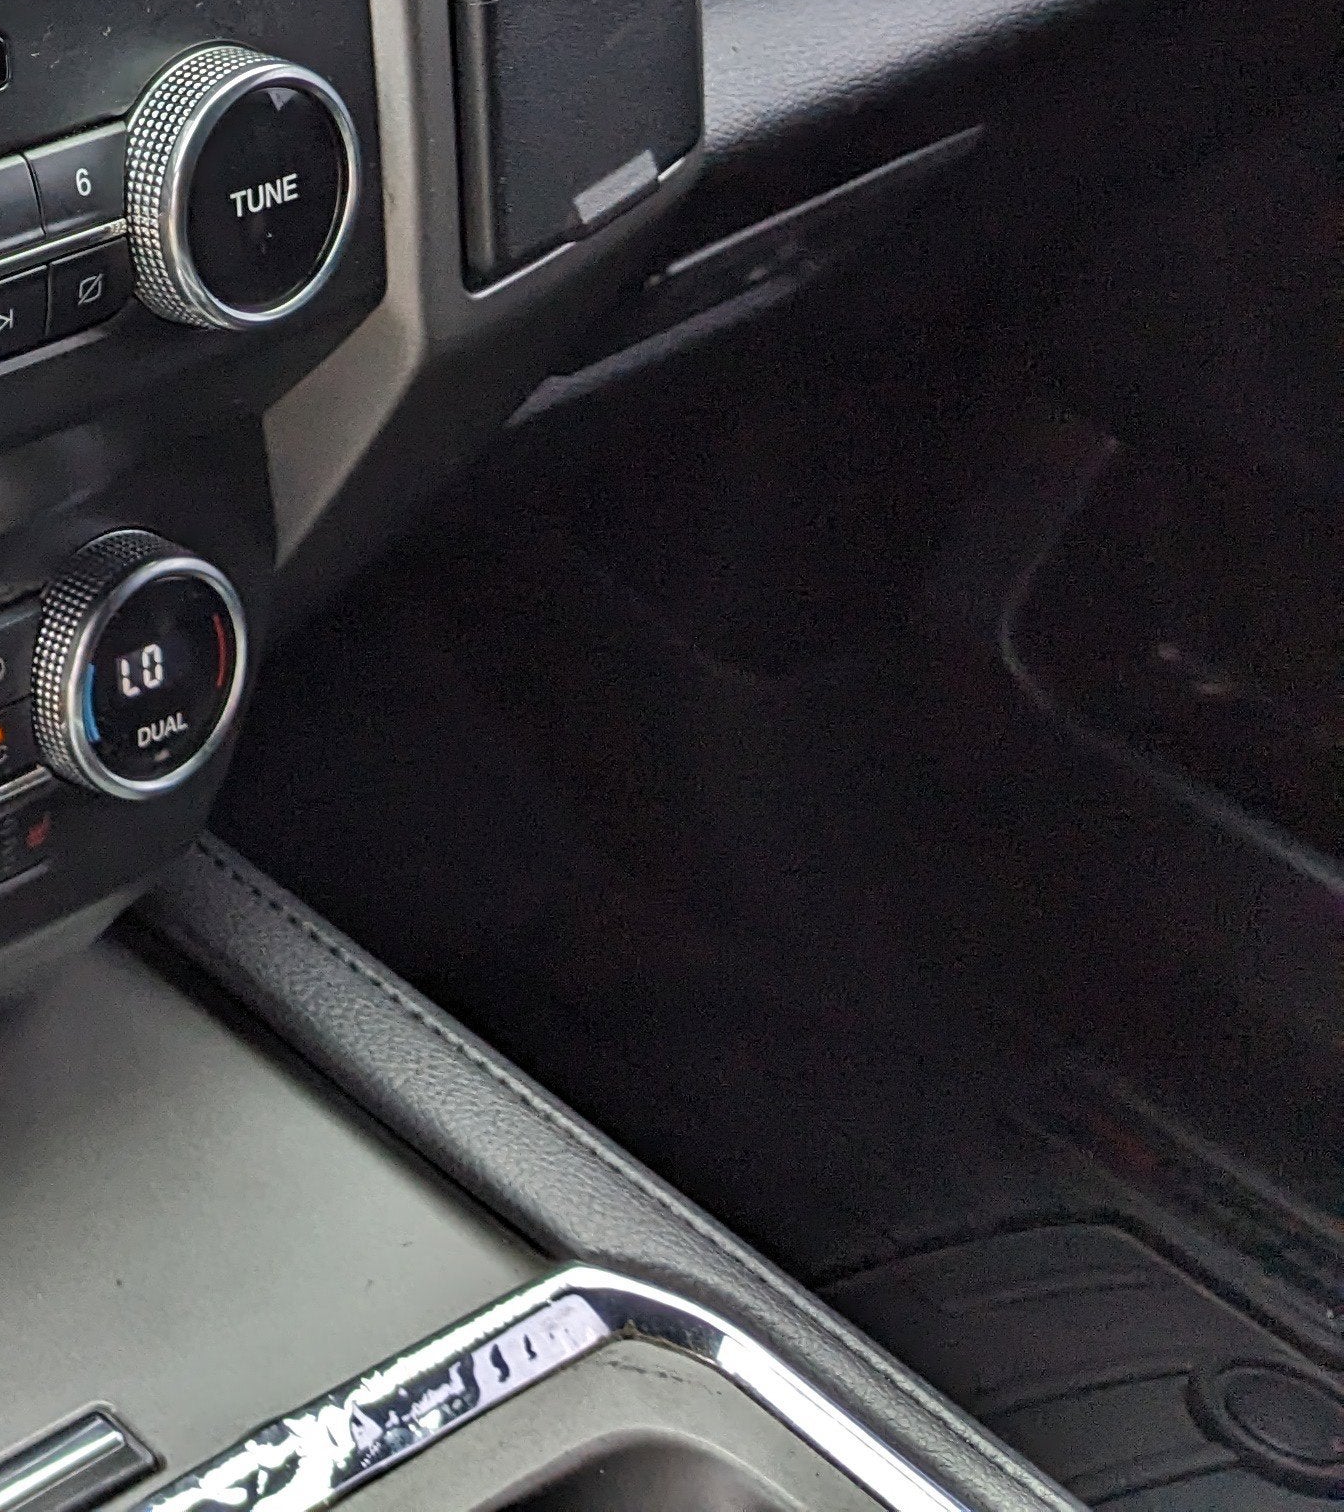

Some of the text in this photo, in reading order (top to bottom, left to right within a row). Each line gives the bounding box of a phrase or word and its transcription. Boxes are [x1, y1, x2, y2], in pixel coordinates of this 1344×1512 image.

[75, 168, 92, 199] 6
[228, 172, 300, 219] TUNE
[119, 644, 163, 698] LO
[134, 711, 189, 750] DUAL
